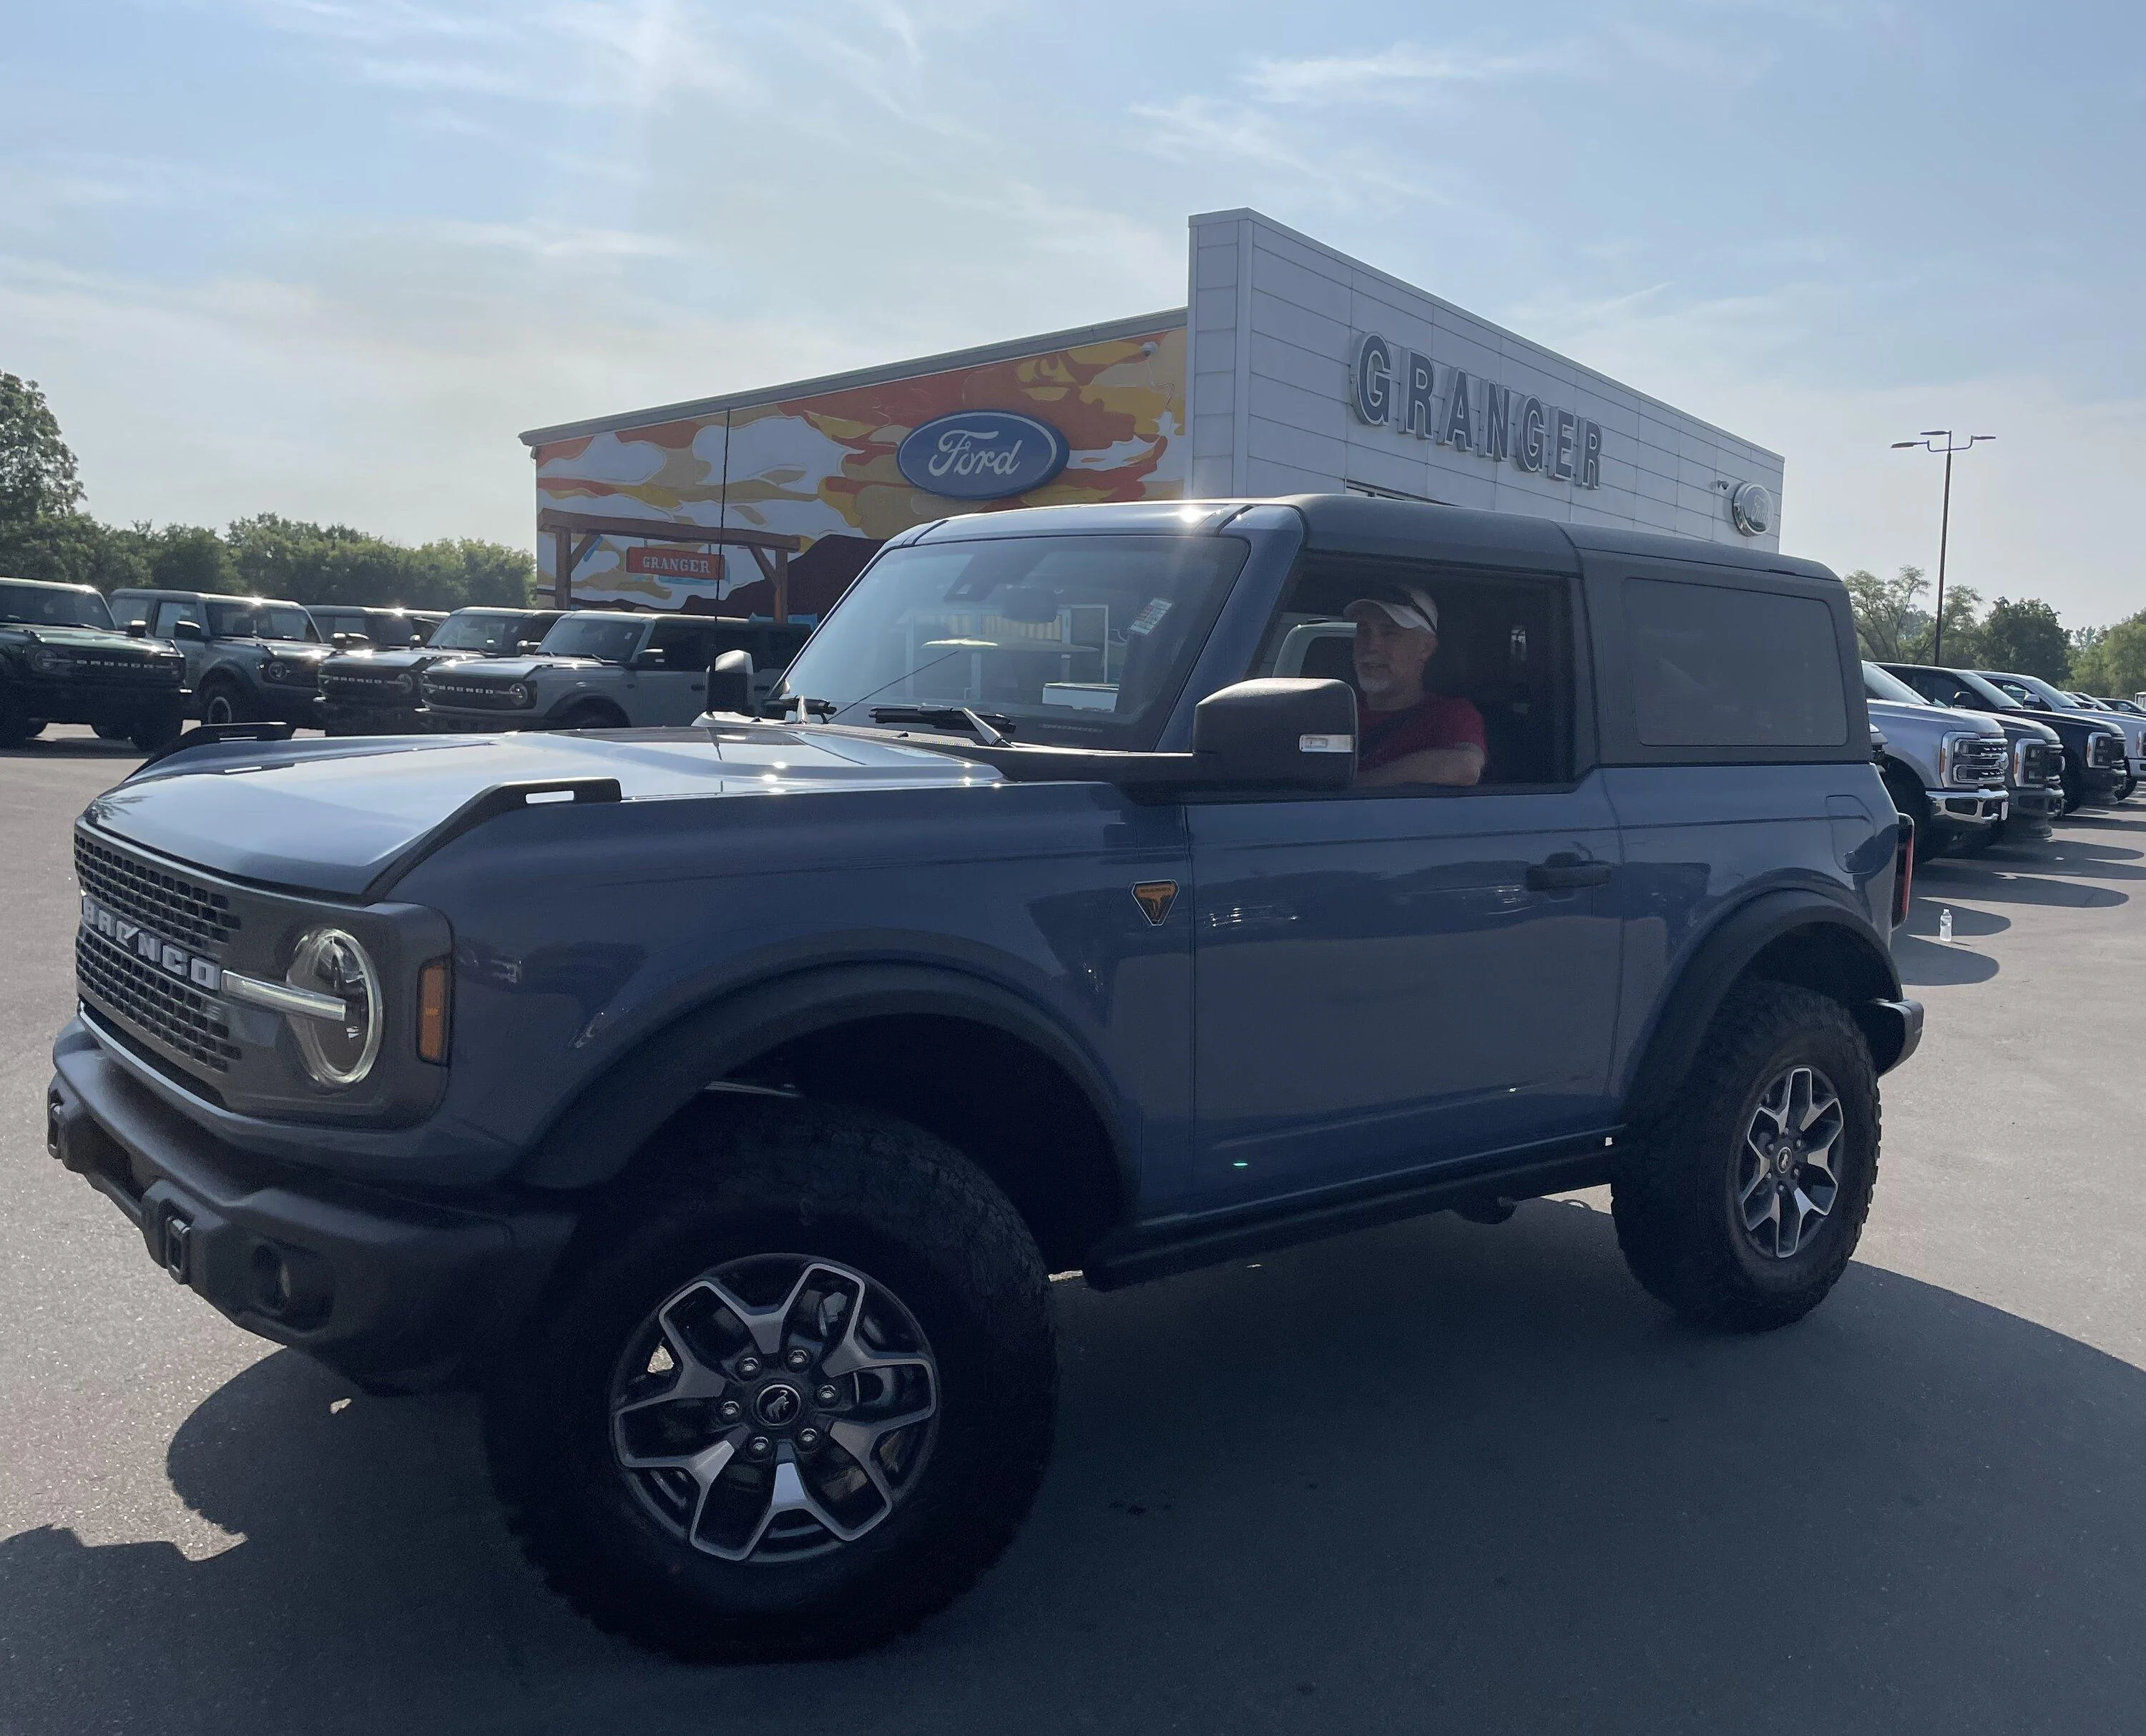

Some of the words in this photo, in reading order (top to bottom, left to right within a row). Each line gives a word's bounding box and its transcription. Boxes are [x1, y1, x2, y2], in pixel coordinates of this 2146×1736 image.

[1351, 331, 1603, 490] GRANGER
[928, 429, 1023, 476] Ford
[642, 556, 710, 573] GRANGER
